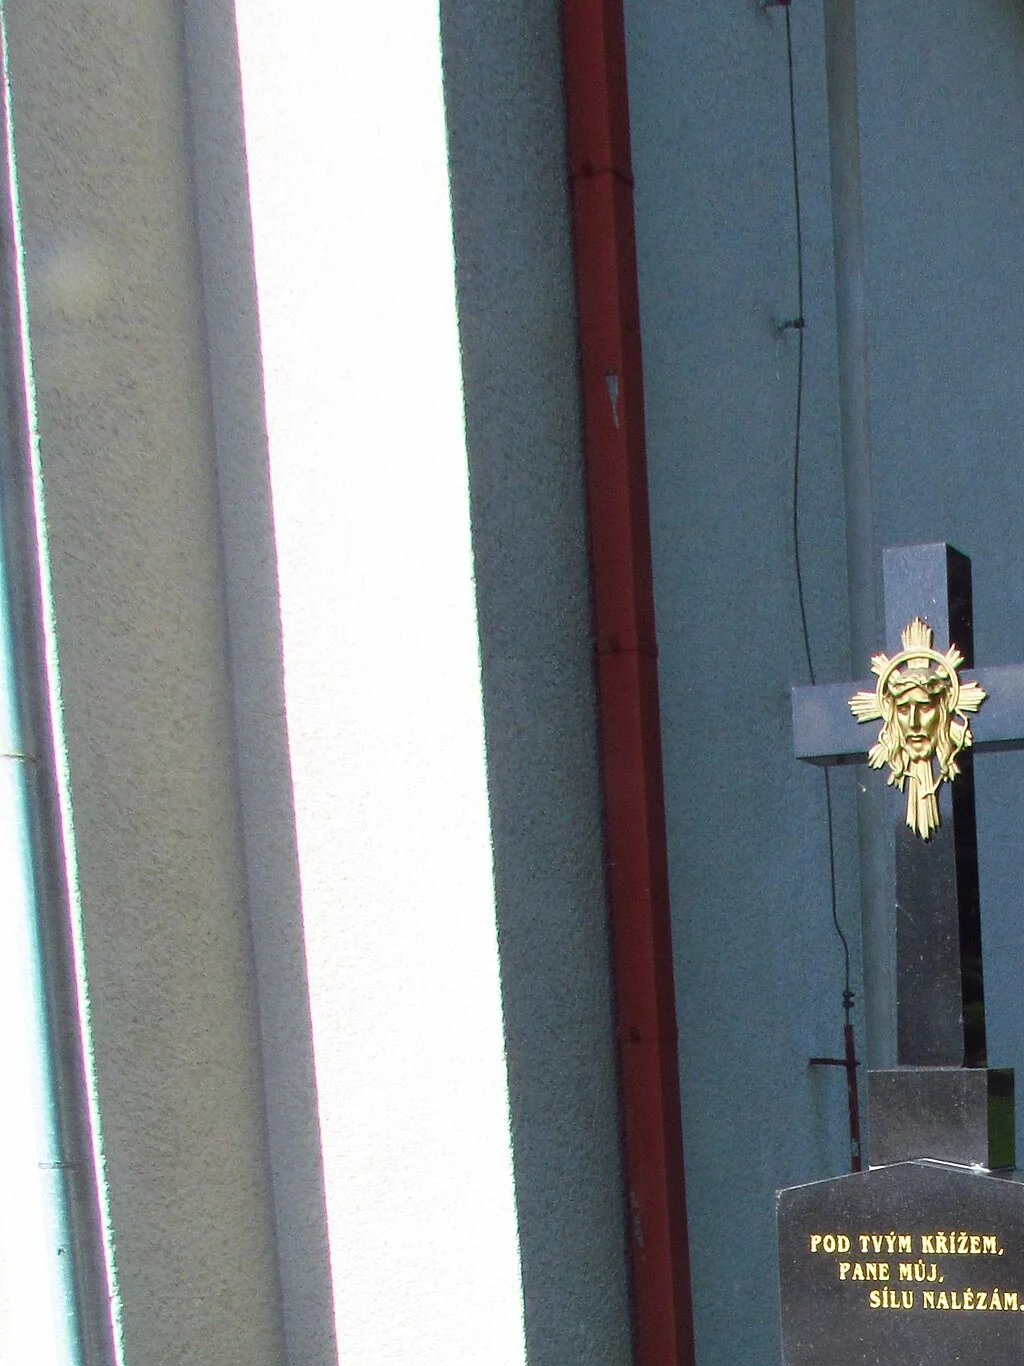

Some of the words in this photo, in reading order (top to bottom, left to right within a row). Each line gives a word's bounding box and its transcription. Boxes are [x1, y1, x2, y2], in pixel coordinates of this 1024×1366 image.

[809, 1234, 851, 1253] POD
[859, 1231, 912, 1254] TVÝM
[921, 1231, 1004, 1256] KŘÍŽEM,
[839, 1262, 890, 1281] PANE
[869, 1286, 914, 1309] SÍLU
